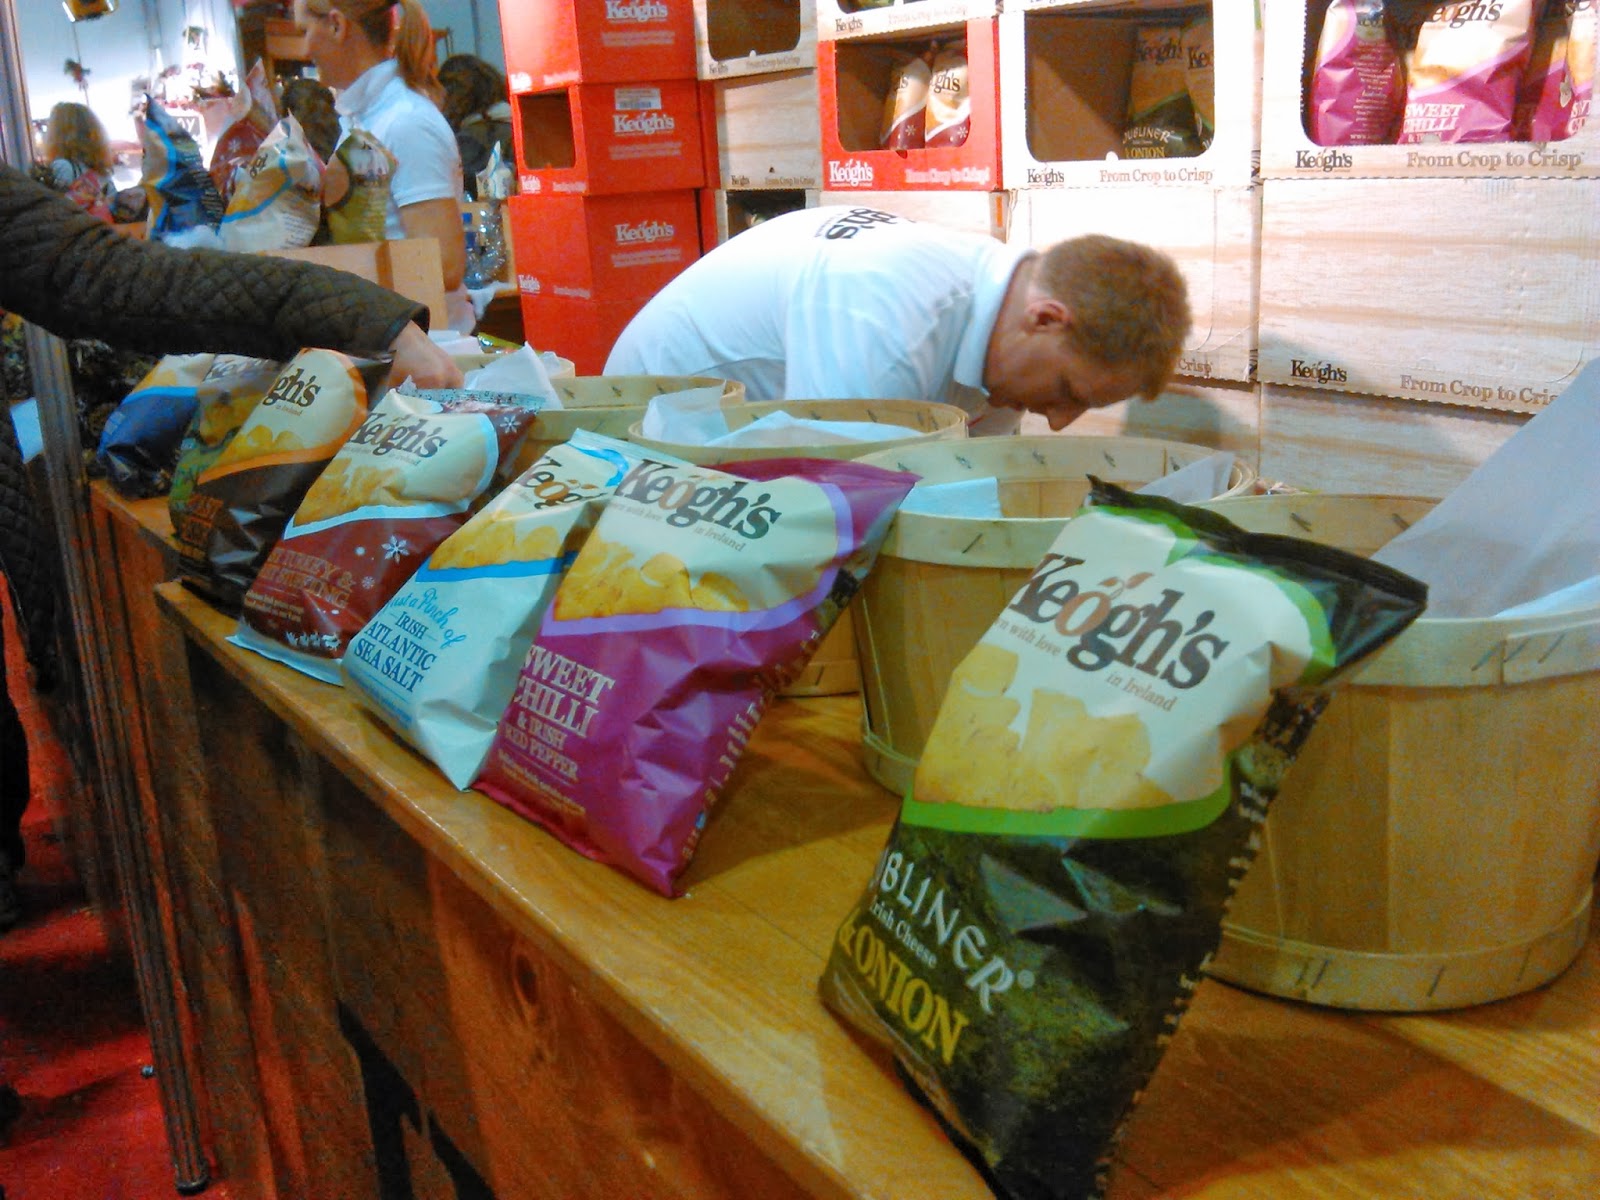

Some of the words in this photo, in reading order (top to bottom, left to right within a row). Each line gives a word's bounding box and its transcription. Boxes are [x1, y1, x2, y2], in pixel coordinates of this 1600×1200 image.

[1430, 0, 1503, 28] eogh's
[930, 69, 960, 94] gh's
[1405, 103, 1465, 117] SWEET
[1100, 169, 1130, 182] From
[1132, 168, 1161, 185] Crop
[1164, 169, 1176, 182] to
[1178, 167, 1213, 185] Crisp
[1407, 152, 1453, 168] From
[1457, 151, 1501, 170] Crop
[1506, 152, 1525, 167] to
[1528, 149, 1578, 169] Crisp
[825, 207, 897, 240] gh's
[262, 368, 321, 407] gh's
[1400, 374, 1447, 394] From
[1450, 379, 1494, 402] Crop
[1498, 384, 1516, 400] to
[417, 587, 458, 629] Pinch
[395, 611, 429, 640] IRISH
[364, 620, 437, 671] ATLANTIC
[1034, 633, 1061, 657] love
[354, 638, 382, 670] SEA
[381, 655, 424, 693] SALT
[1106, 671, 1119, 687] in
[1122, 676, 1178, 713] Ireland
[873, 850, 1014, 1015] BLINER
[895, 919, 938, 970] Cheese
[855, 924, 970, 1065] ONION
